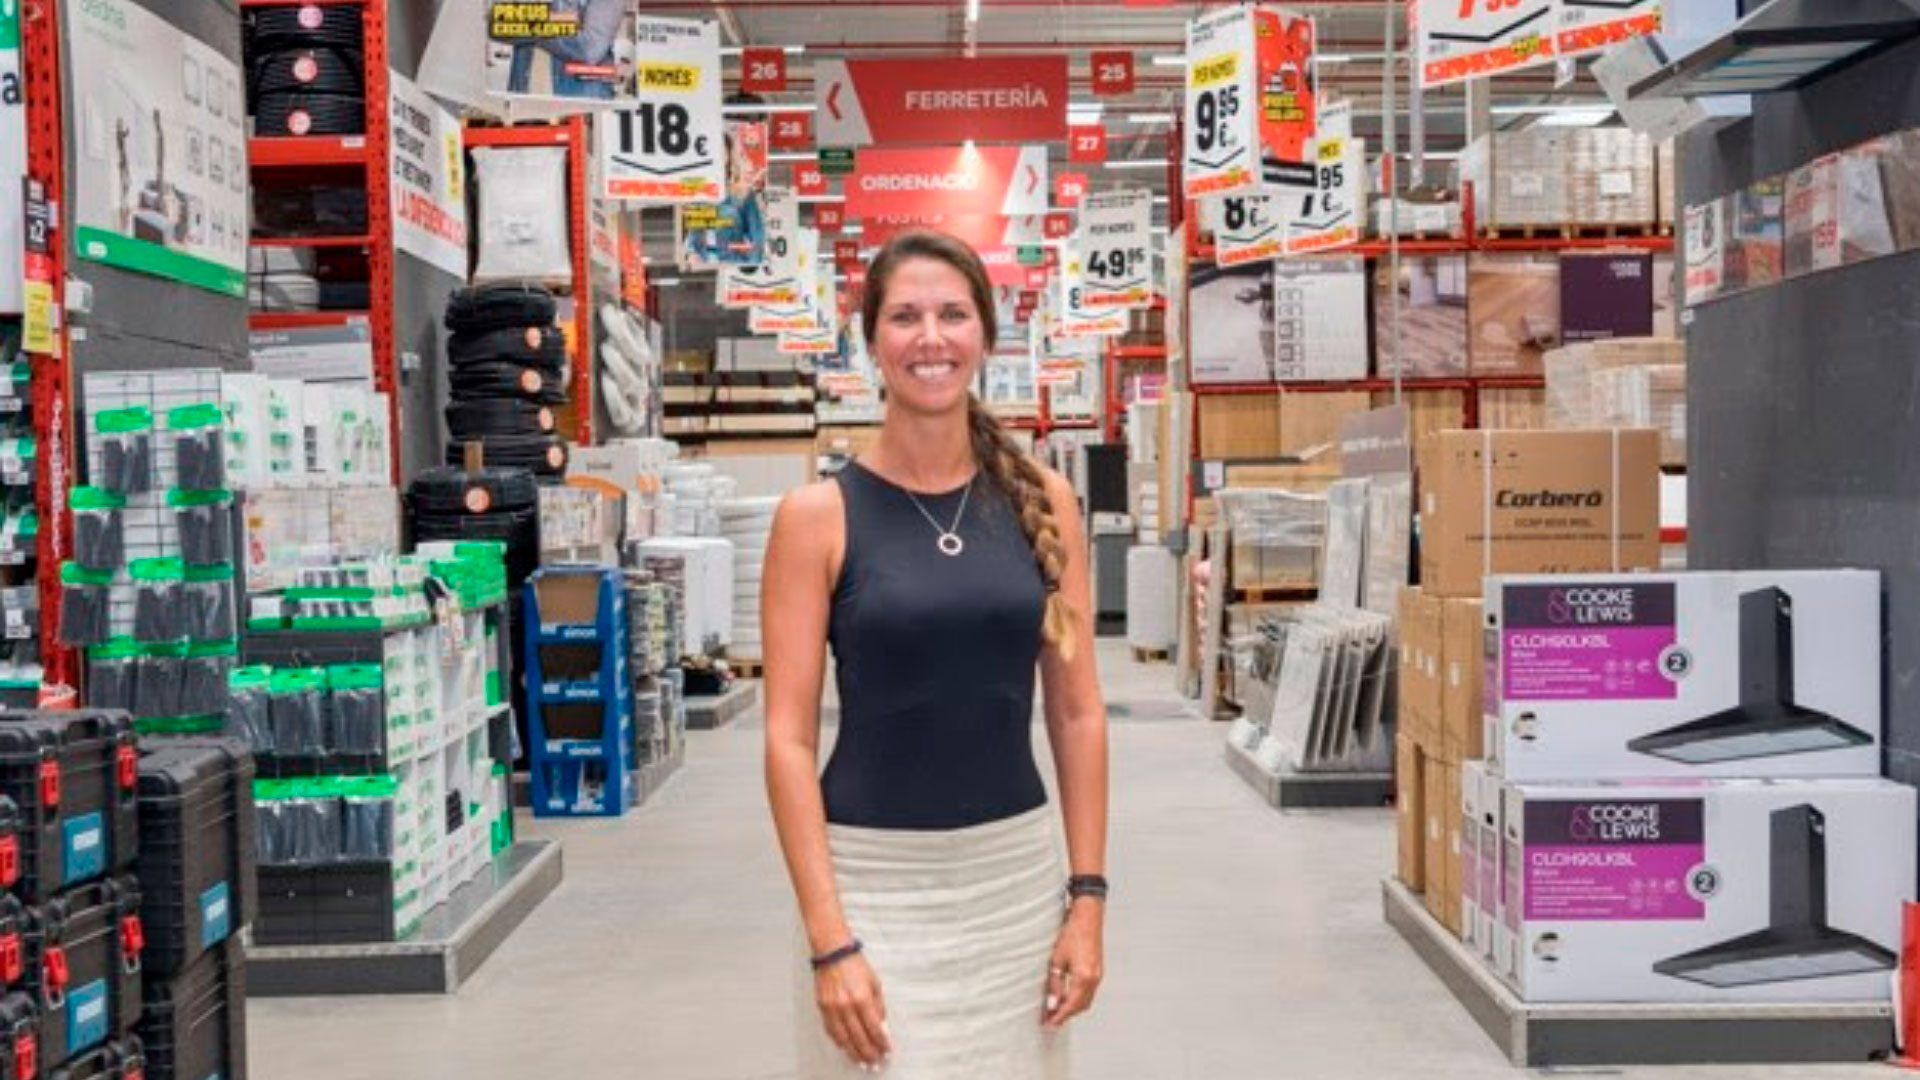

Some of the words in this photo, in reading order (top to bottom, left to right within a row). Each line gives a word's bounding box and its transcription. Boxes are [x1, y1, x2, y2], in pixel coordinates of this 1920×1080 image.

[751, 62, 778, 80] 26
[1099, 63, 1126, 80] 25
[614, 102, 690, 156] 118
[778, 120, 802, 137] 28
[1195, 90, 1215, 152] 9
[1076, 135, 1100, 150] 27
[1087, 250, 1126, 279] 49
[1566, 588, 1634, 605] COOKE
[1577, 606, 1634, 623] LEWIS
[1589, 804, 1659, 822] COOKE
[1600, 821, 1660, 839] LEWIS
